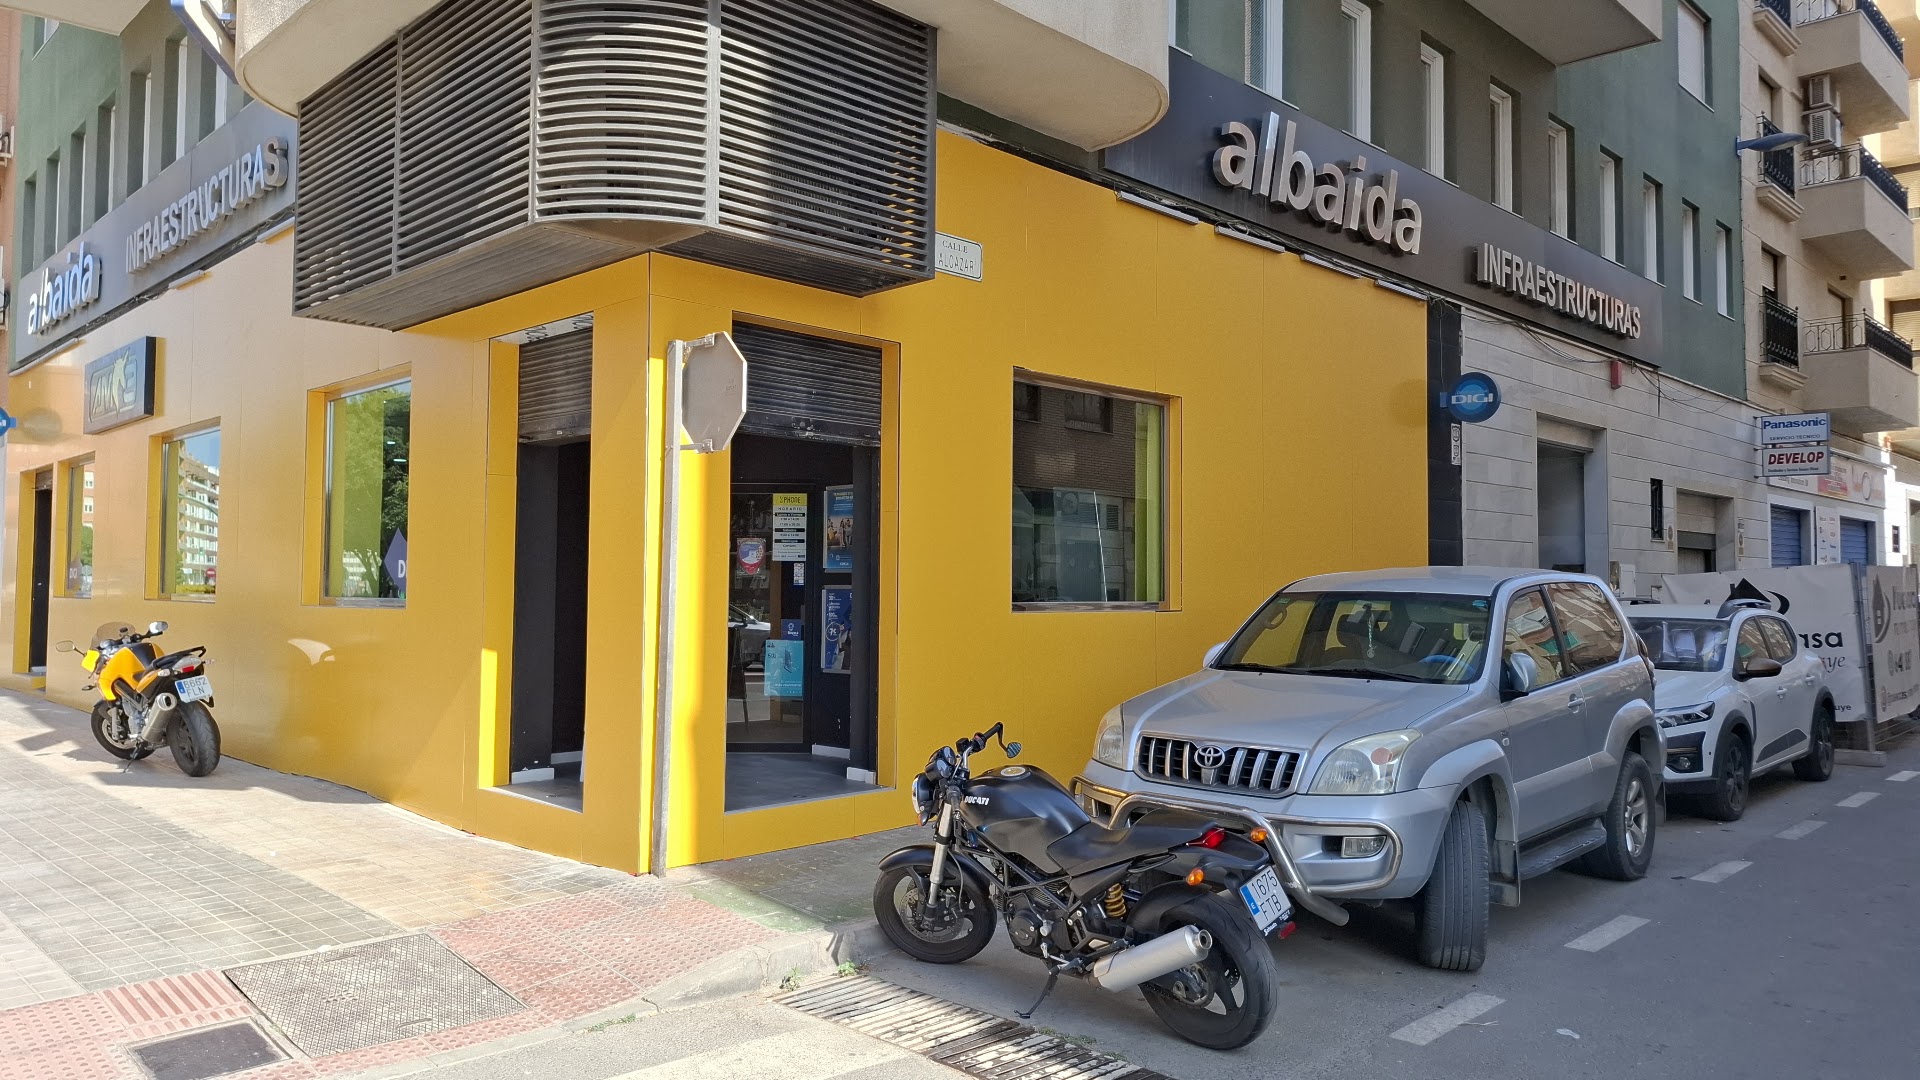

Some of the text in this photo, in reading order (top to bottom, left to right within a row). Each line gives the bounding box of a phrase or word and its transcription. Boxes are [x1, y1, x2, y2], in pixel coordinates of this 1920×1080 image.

[1212, 111, 1424, 256] albaida
[125, 136, 289, 274] INFRAESTRUCTURAS
[942, 240, 968, 253] CALLE
[28, 241, 102, 336] albaida
[1477, 241, 1642, 340] INFRAESTRUCTURAS
[1451, 392, 1494, 405] DIGI
[1763, 416, 1827, 430] Panasonic
[1768, 451, 1825, 466] DEVELOP
[187, 686, 205, 697] FLN
[964, 795, 990, 806] DUCATI
[1251, 869, 1278, 899] 1675
[1259, 894, 1282, 922] FTB
